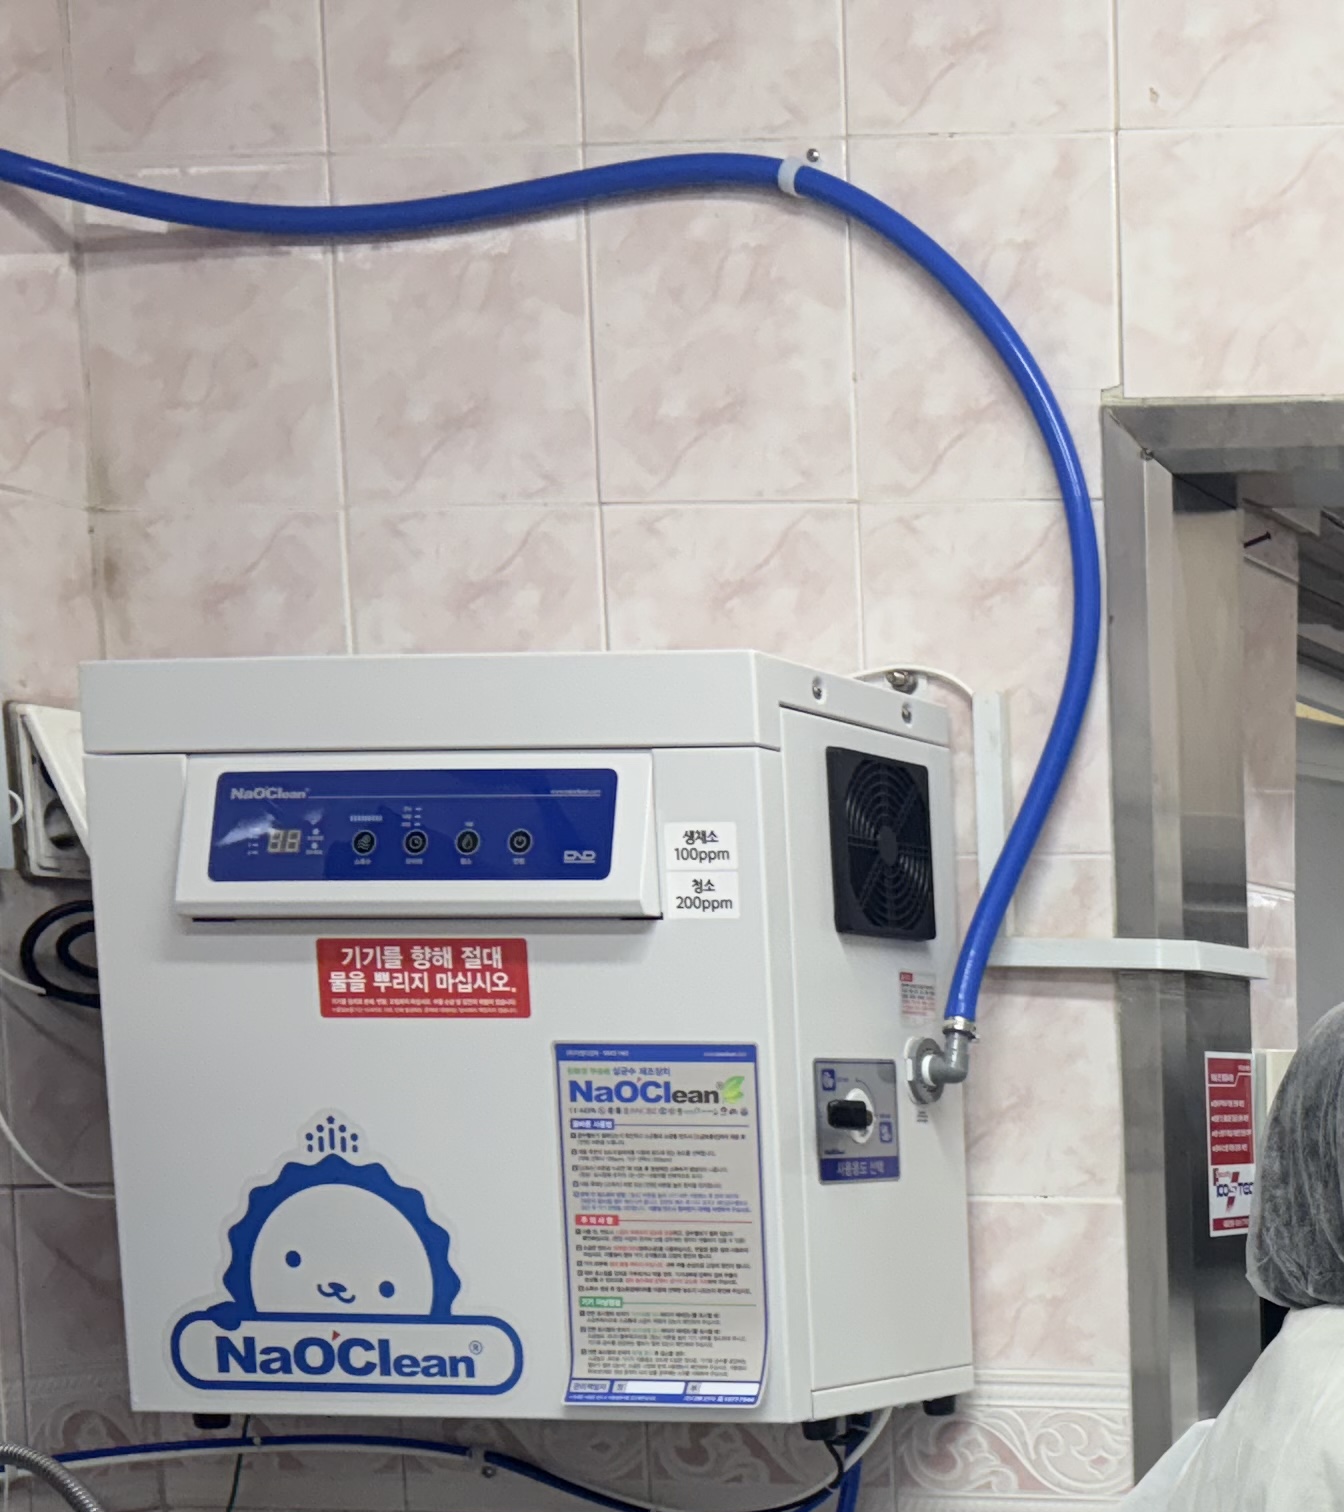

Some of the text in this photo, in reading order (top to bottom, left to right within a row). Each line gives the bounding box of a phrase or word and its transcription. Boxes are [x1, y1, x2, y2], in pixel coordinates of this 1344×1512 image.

[682, 829, 719, 845] 생채소
[674, 847, 730, 863] 100ppm
[691, 879, 716, 894] 청소
[675, 896, 733, 912] 200ppm
[341, 946, 503, 970] 기기를 향해 절대
[328, 971, 517, 993] 물을 뿌리지 마십시오.
